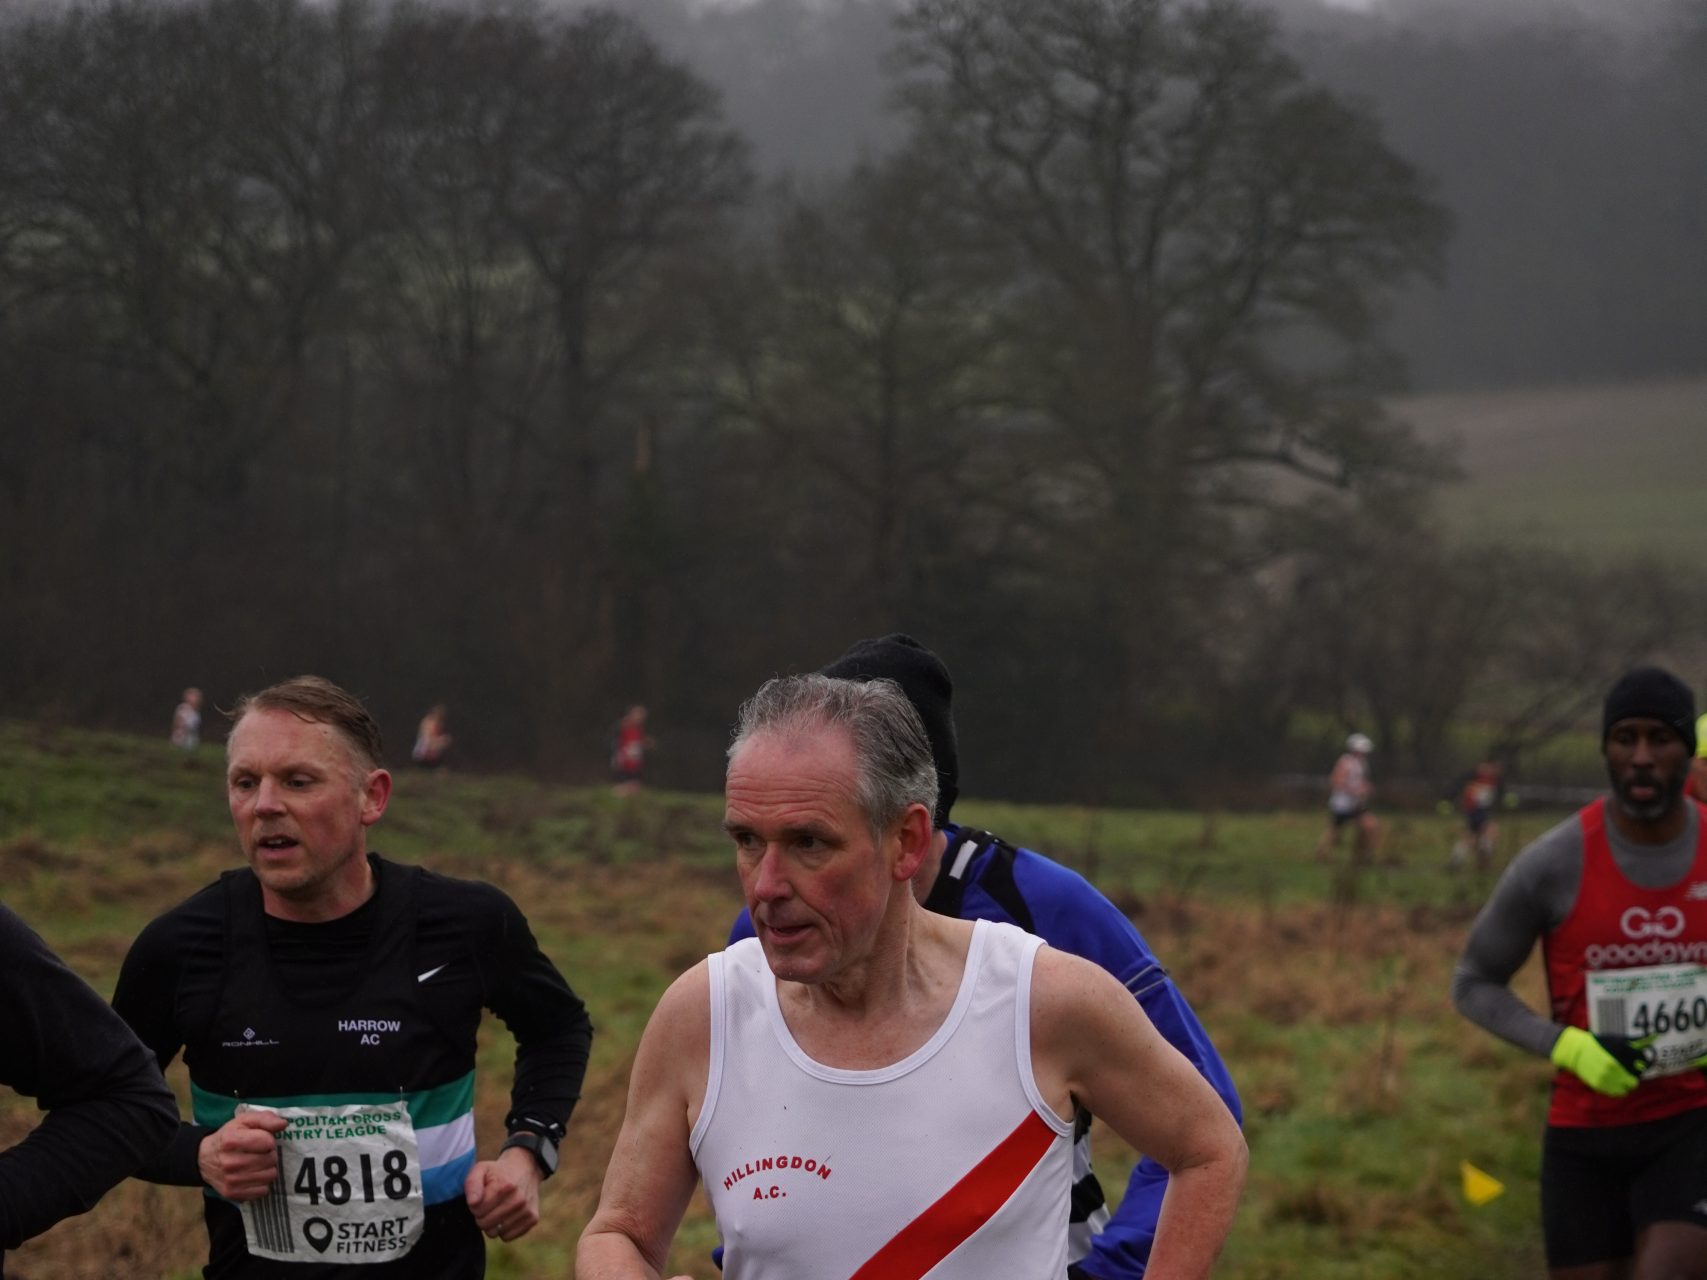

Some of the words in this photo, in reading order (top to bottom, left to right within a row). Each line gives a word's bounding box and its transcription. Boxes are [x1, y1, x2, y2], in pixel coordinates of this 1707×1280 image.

[1633, 996, 1707, 1037] 4660
[338, 1020, 401, 1032] HARROW
[360, 1034, 380, 1045] AC
[287, 1115, 347, 1128] POLITAN
[352, 1112, 401, 1126] CROSS
[274, 1127, 323, 1140] UNTRY
[325, 1125, 387, 1139] LEAGUE
[294, 1150, 411, 1205] 4818
[723, 1156, 832, 1191] HILLINGDON
[753, 1186, 786, 1200] A.C.
[338, 1216, 409, 1240] START
[336, 1236, 407, 1254] FITNESS
